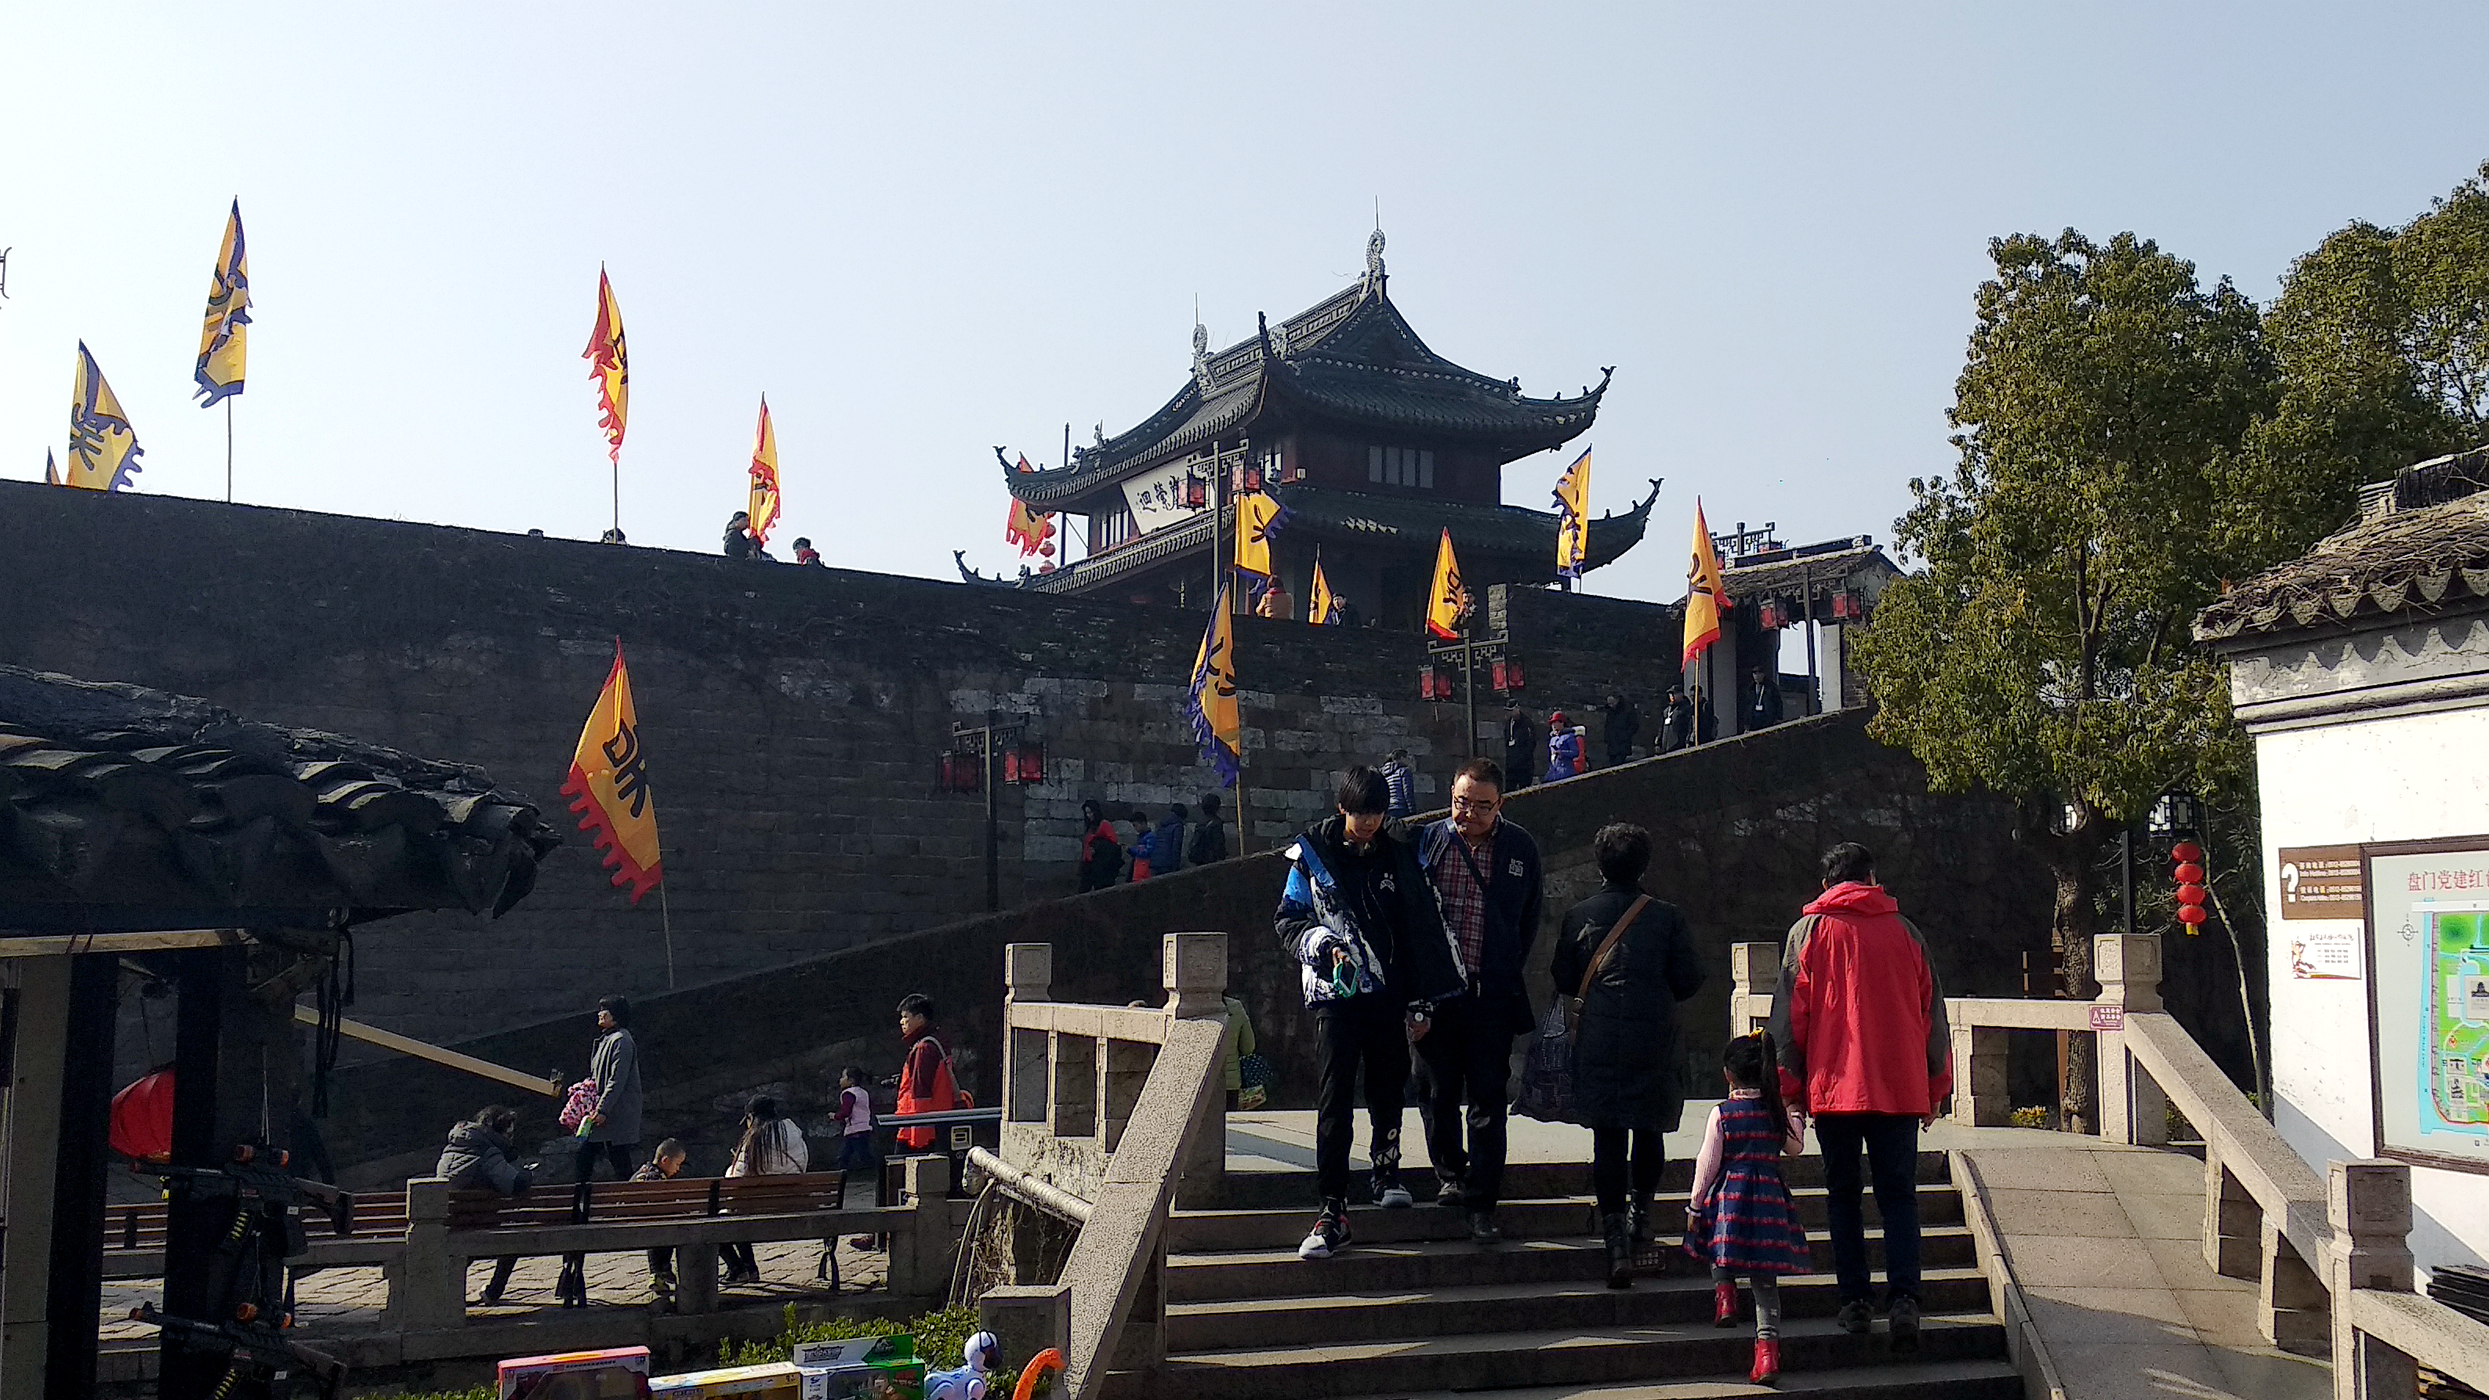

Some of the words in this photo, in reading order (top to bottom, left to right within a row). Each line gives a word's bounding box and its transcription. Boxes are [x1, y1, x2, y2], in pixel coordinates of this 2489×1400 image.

[2408, 868, 2489, 892] 盘门党建红
